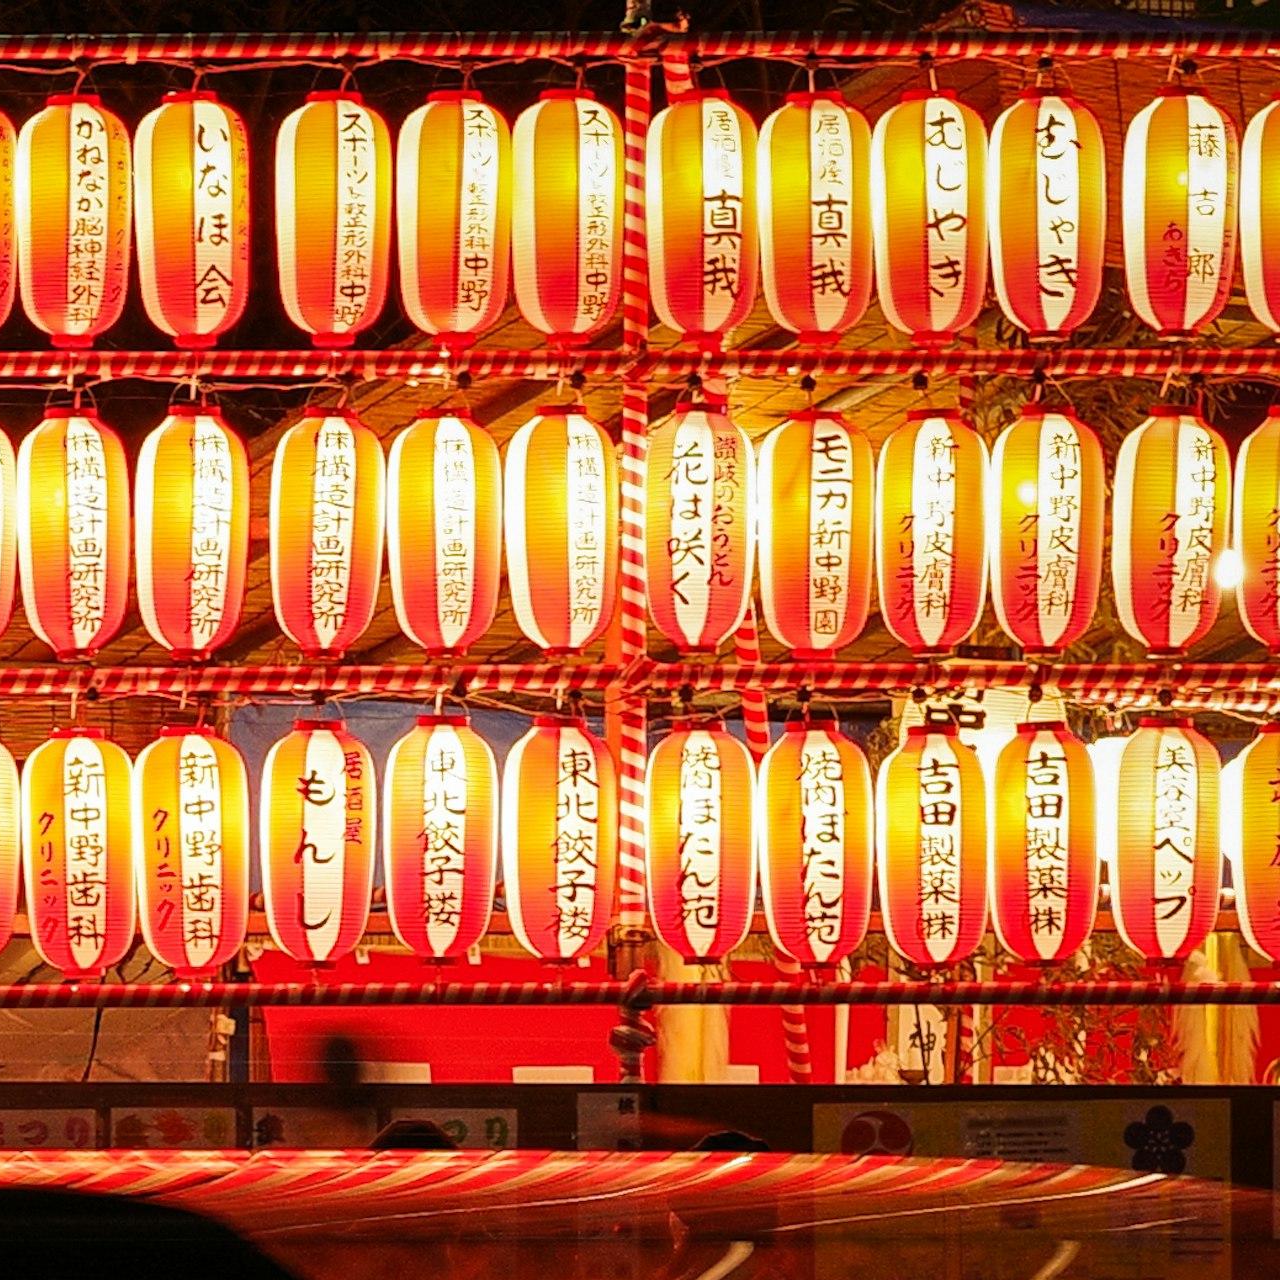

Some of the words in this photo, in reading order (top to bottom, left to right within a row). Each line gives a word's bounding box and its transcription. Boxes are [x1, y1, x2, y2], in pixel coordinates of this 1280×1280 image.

[70, 116, 106, 328] かねなか脳神経外科
[195, 122, 233, 309] いなほ会
[1161, 221, 1186, 291] あきら
[1186, 124, 1222, 284] 藤吉郎
[665, 440, 709, 605] 花は咲く
[896, 515, 915, 623] クリニック
[918, 435, 960, 617] 新中野皮膚科
[1016, 515, 1041, 624] クリニック
[1042, 433, 1080, 615] 新中野皮膚科
[1150, 513, 1179, 623] クリニック
[1177, 437, 1217, 616] 新中野皮膚科
[38, 811, 58, 934] クリニック
[64, 757, 105, 948] 新中野歯科
[152, 809, 177, 931] クリニック
[179, 753, 221, 947] 新中野歯科
[342, 753, 364, 844] 居酒屋
[417, 749, 465, 927] 東北餃子楼
[549, 749, 598, 941] 東北餃子楼
[1153, 747, 1197, 921] 美容室ペップ
